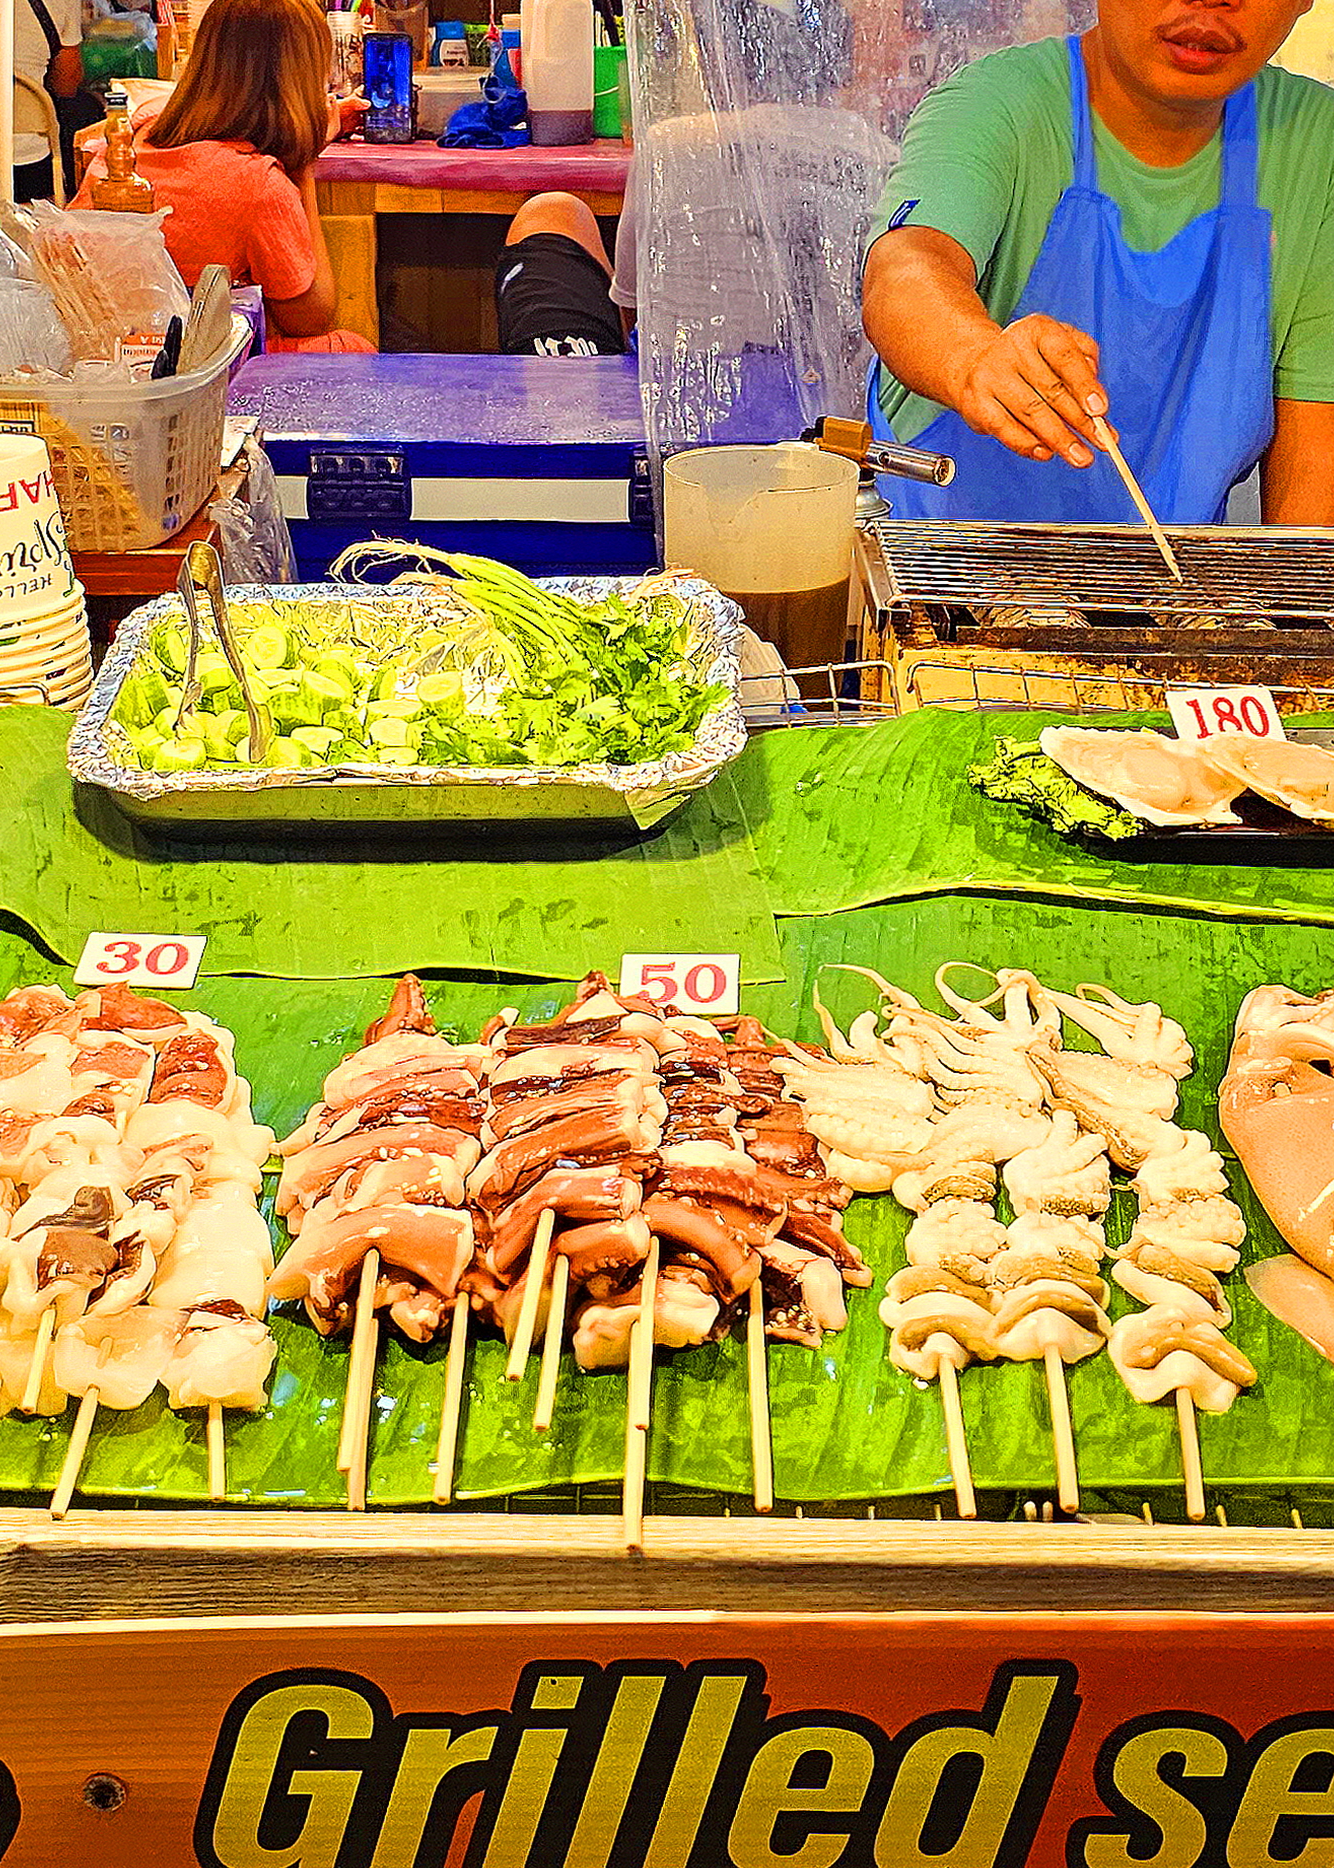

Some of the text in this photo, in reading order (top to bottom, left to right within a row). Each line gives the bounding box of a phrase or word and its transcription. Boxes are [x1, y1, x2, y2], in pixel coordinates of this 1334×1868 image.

[1185, 695, 1270, 740] 180
[95, 941, 190, 976] 30
[636, 961, 727, 1004] 50
[211, 1674, 1059, 1868] Grilled
